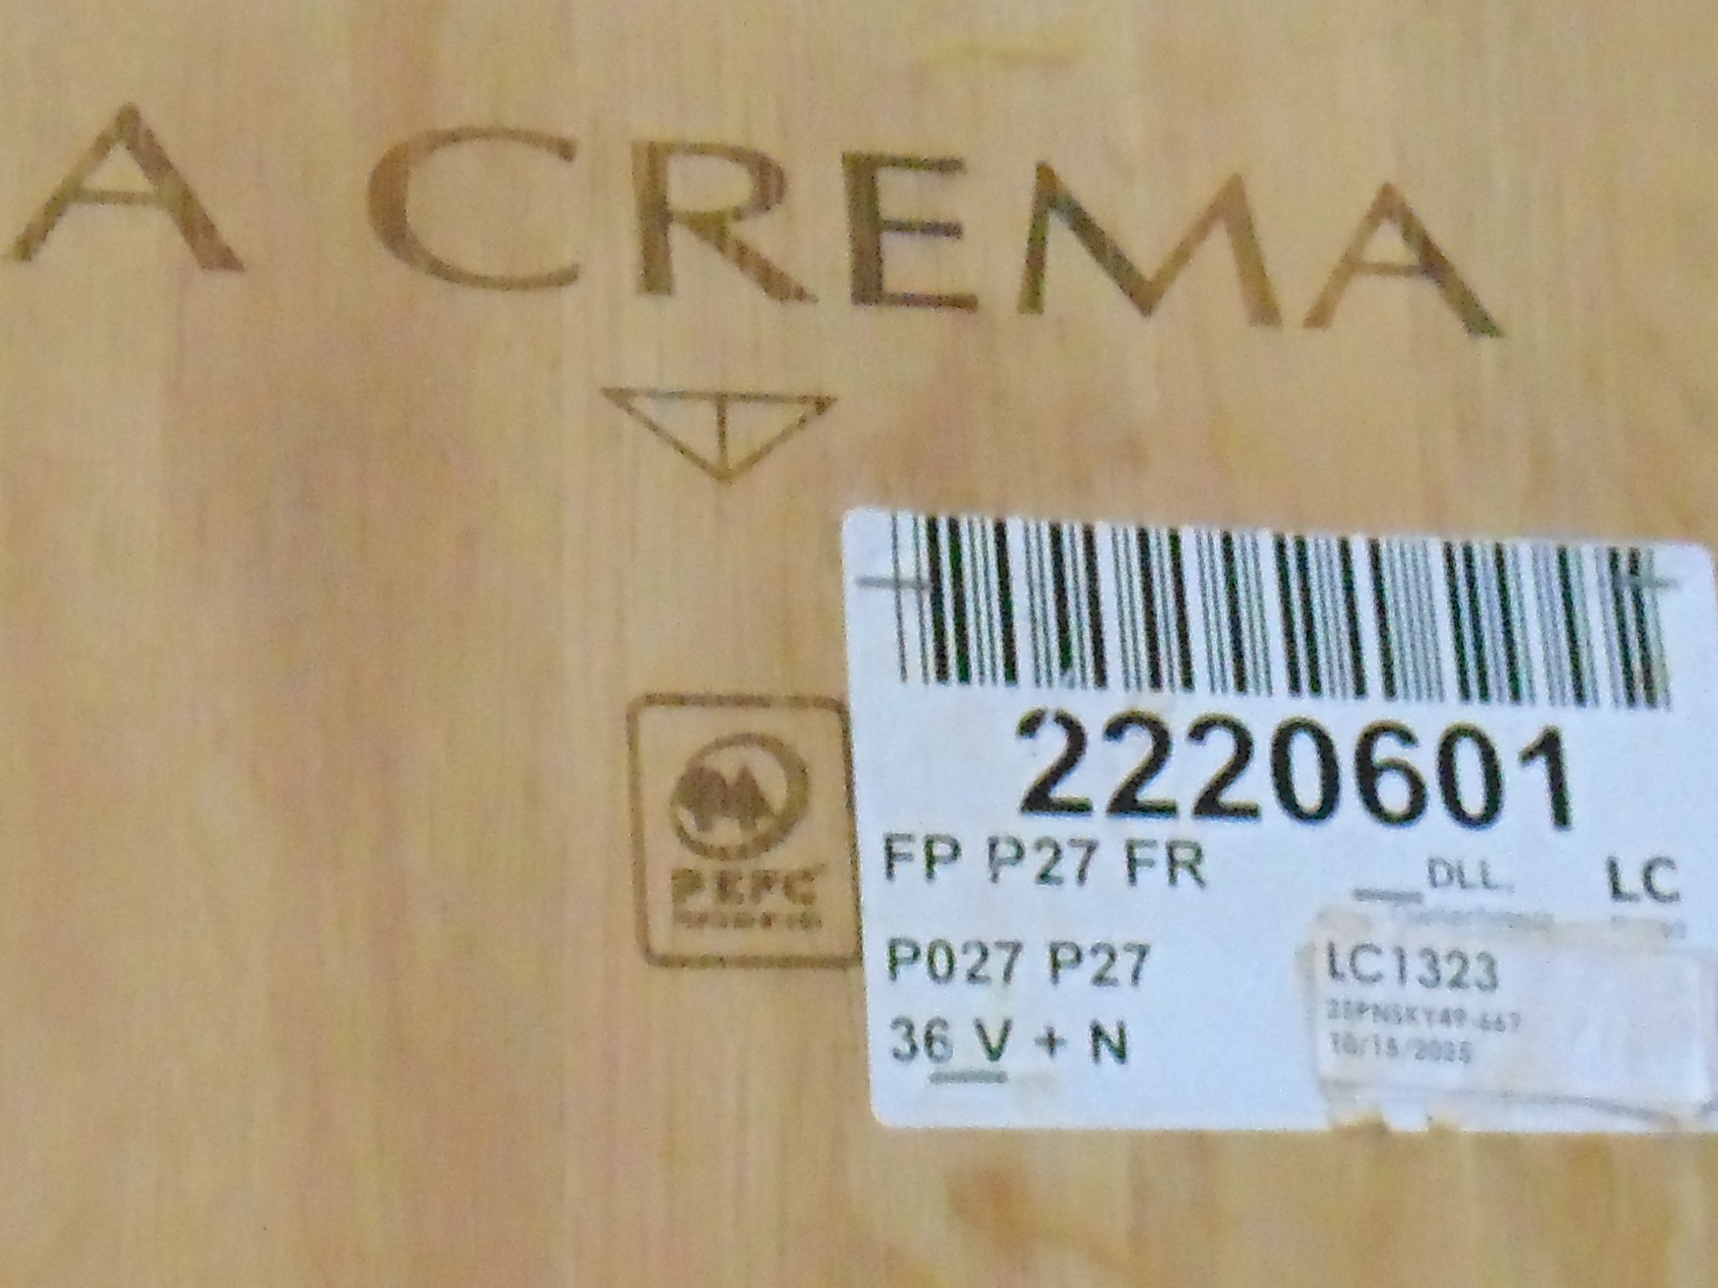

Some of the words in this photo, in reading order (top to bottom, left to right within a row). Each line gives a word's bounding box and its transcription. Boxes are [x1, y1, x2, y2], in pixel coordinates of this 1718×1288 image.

[365, 123, 1506, 340] CREMA
[1015, 707, 1574, 831] 2220601
[883, 830, 964, 884] FP
[987, 833, 1101, 888] P27
[1124, 836, 1209, 890] FR
[1605, 854, 1681, 904] LC
[886, 935, 1026, 985] P027
[1048, 939, 1152, 988] P27
[1325, 939, 1500, 994] LC1323
[889, 1015, 954, 1064] 36
[972, 1016, 1013, 1063] V
[1034, 1024, 1068, 1059] +
[1089, 1017, 1129, 1066] N
